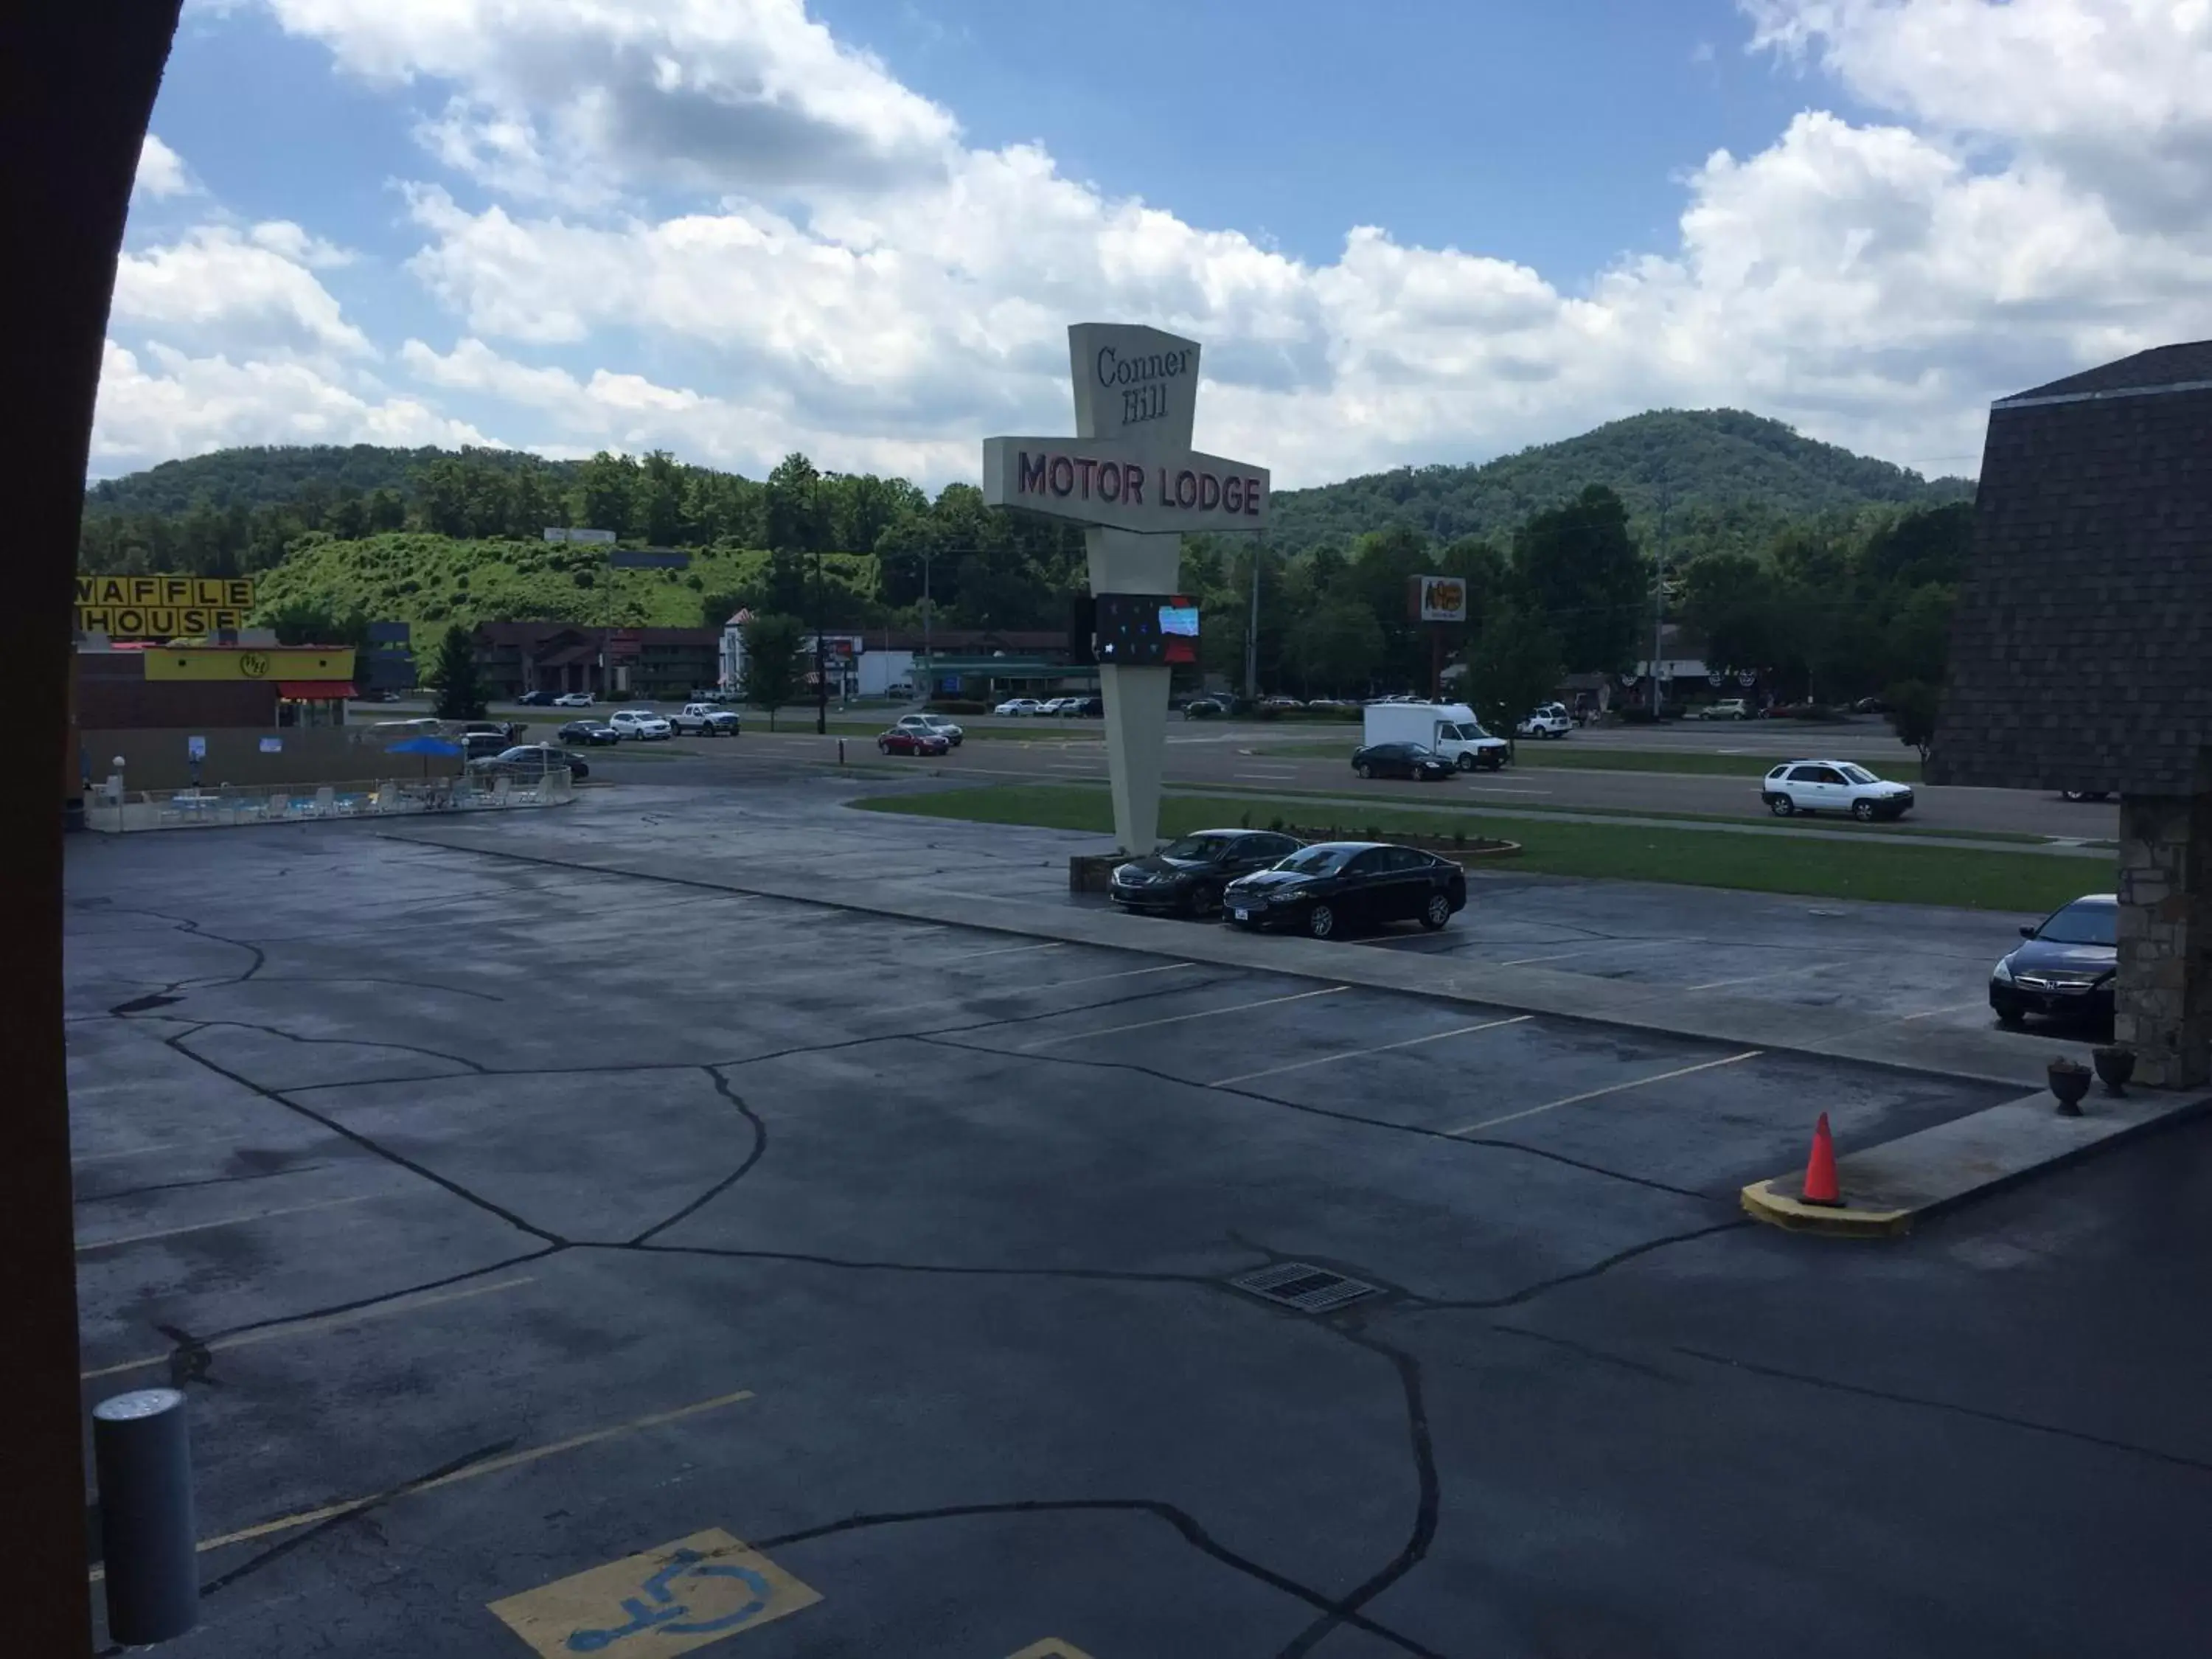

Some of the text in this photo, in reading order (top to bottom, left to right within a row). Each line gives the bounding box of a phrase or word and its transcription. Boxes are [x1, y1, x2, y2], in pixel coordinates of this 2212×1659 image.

[1097, 346, 1192, 388] Conner
[1121, 383, 1168, 425] Hill
[1018, 451, 1260, 516] MOTOR LODGE
